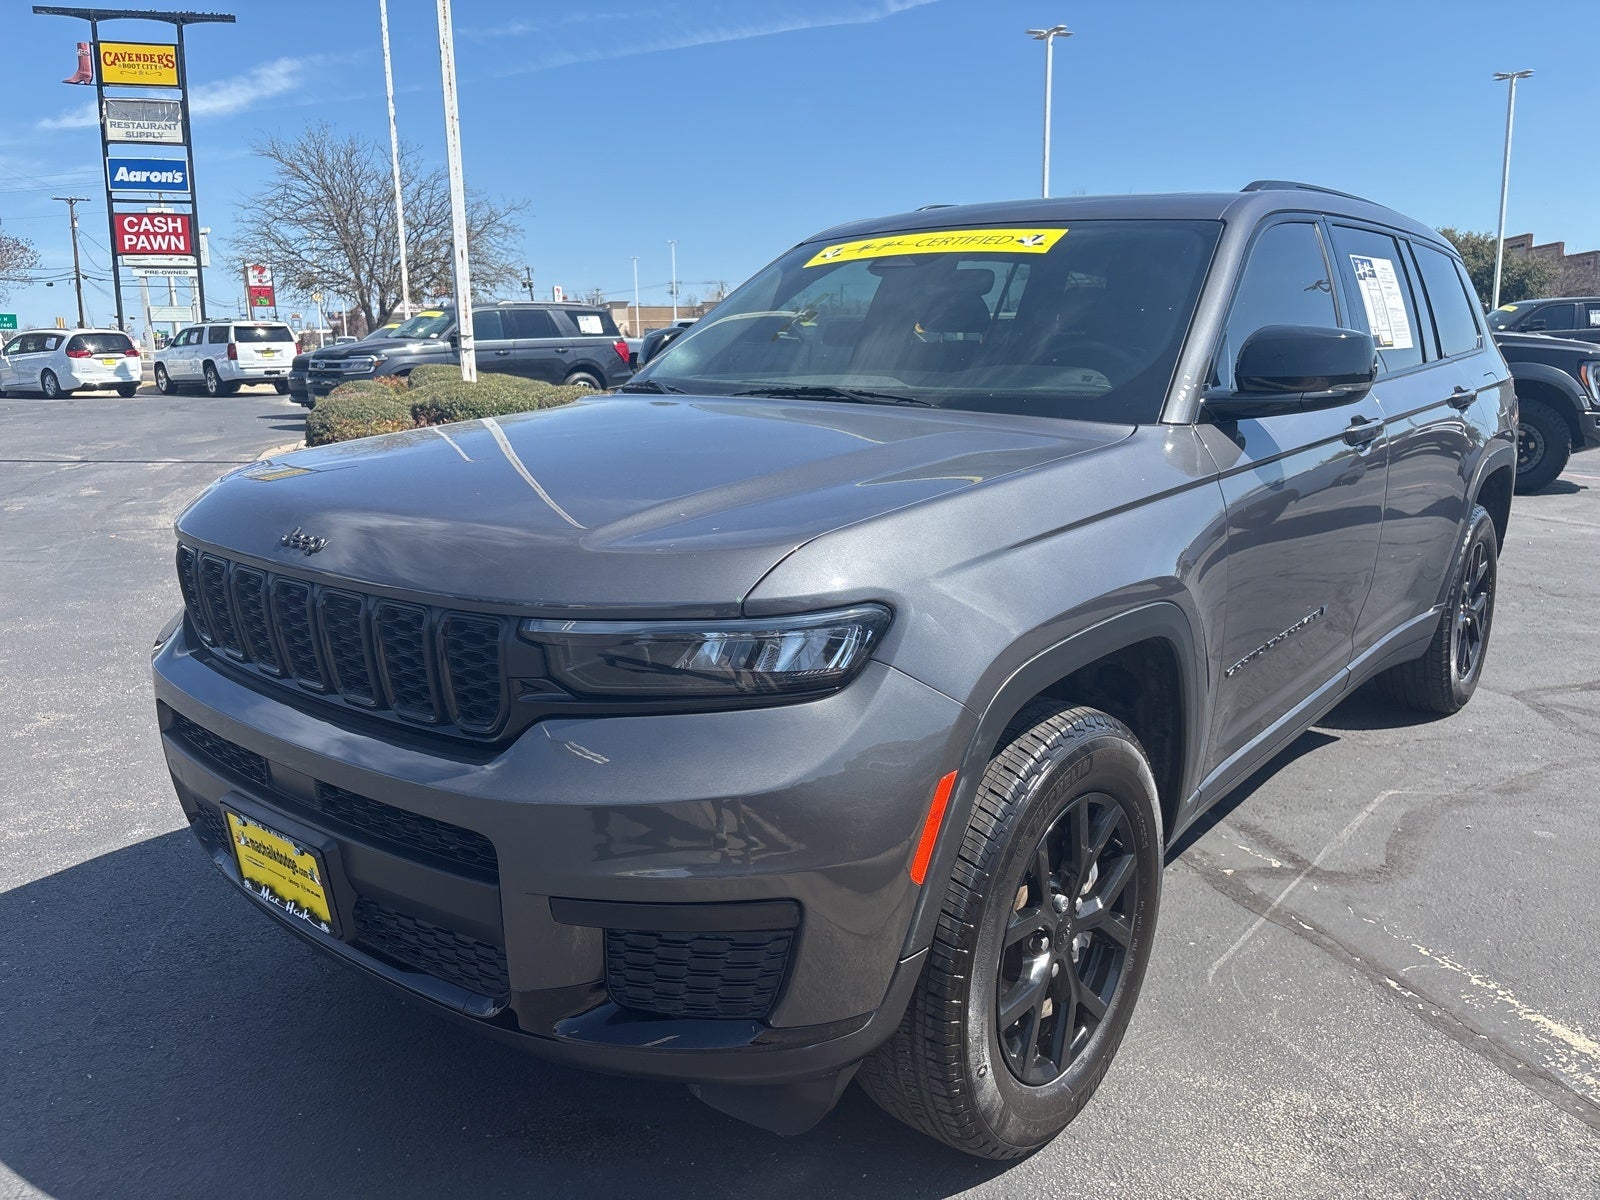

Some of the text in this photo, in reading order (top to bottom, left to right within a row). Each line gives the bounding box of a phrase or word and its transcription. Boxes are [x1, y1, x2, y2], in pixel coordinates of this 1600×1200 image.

[102, 51, 175, 69] CAVENDER'S
[109, 121, 178, 131] RESTAURANT
[125, 131, 165, 139] SUPPLY
[114, 166, 184, 183] Aaron's
[123, 216, 183, 233] CASH
[123, 234, 186, 251] PAWN
[915, 235, 1015, 248] CERTIFIED
